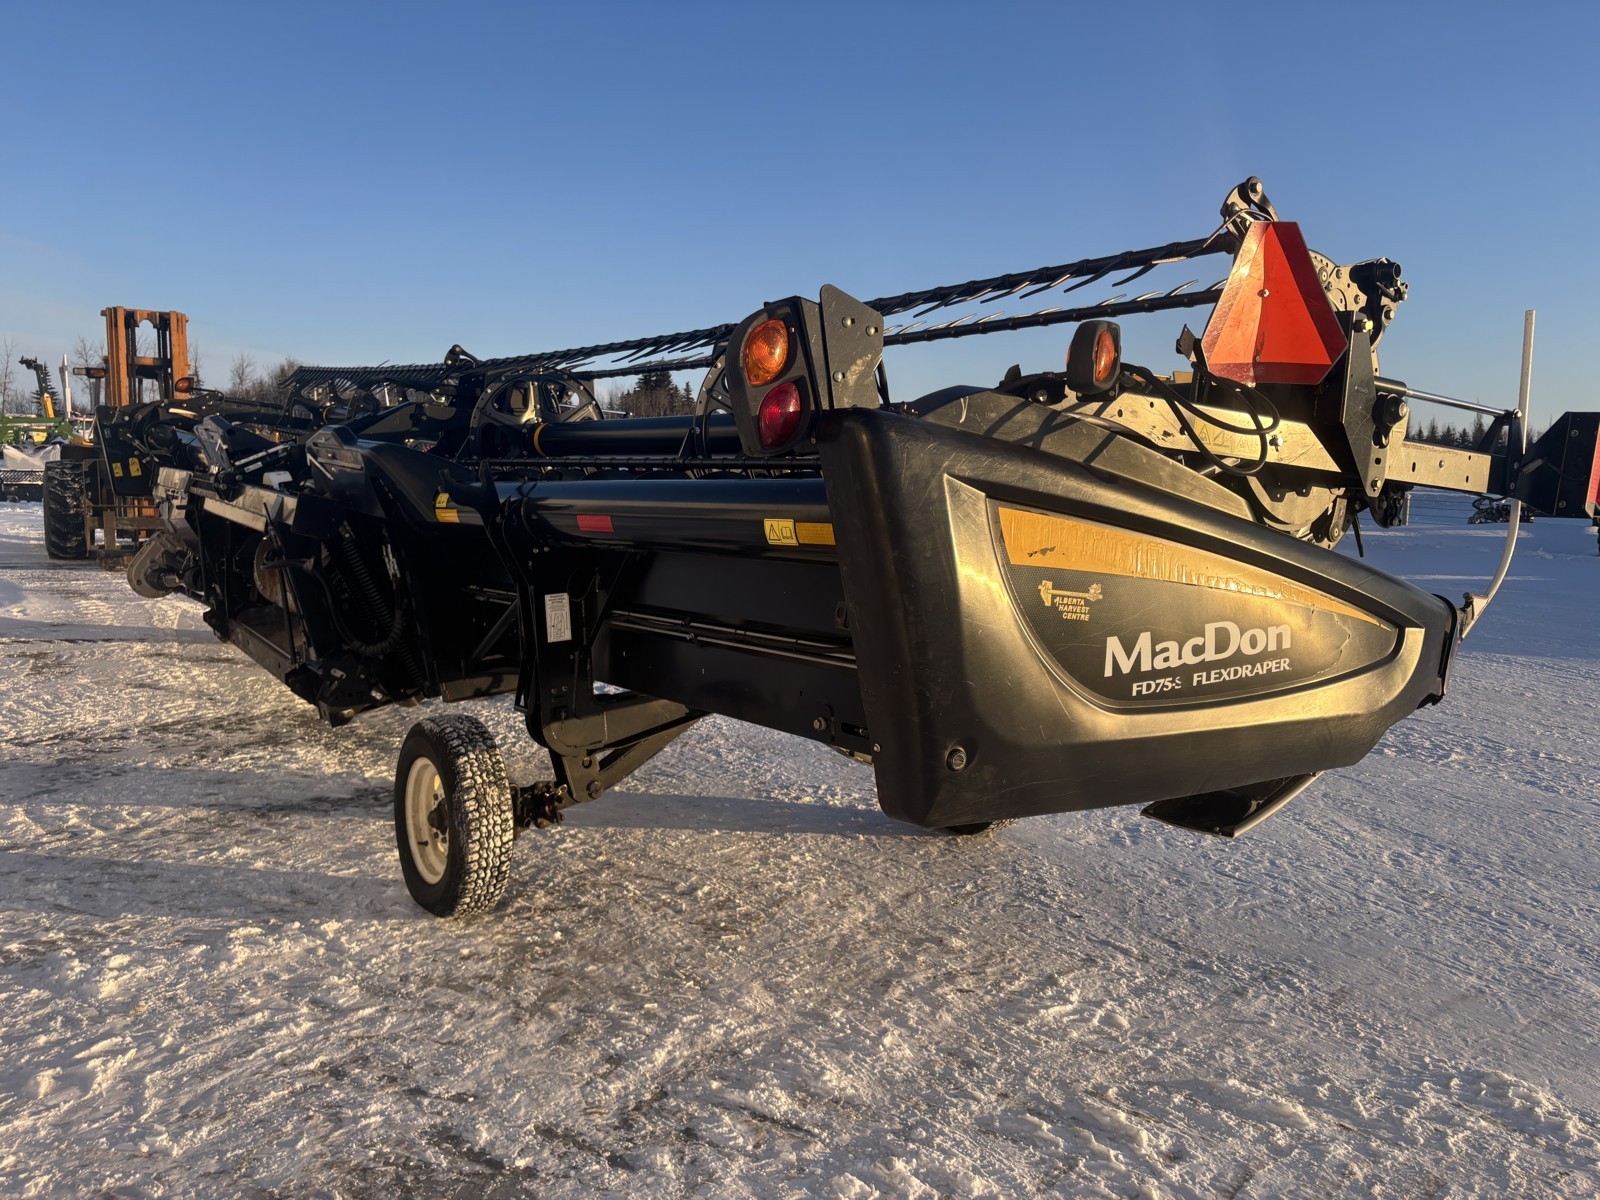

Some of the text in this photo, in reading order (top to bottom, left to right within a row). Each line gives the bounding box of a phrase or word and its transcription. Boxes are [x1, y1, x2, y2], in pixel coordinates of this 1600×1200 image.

[1054, 596, 1085, 606] ALBERTA
[1059, 605, 1090, 613] HARVEST
[1062, 612, 1090, 621] CENTRE
[1103, 621, 1292, 677] MacDon
[1192, 658, 1291, 686] FLEXDRAPER
